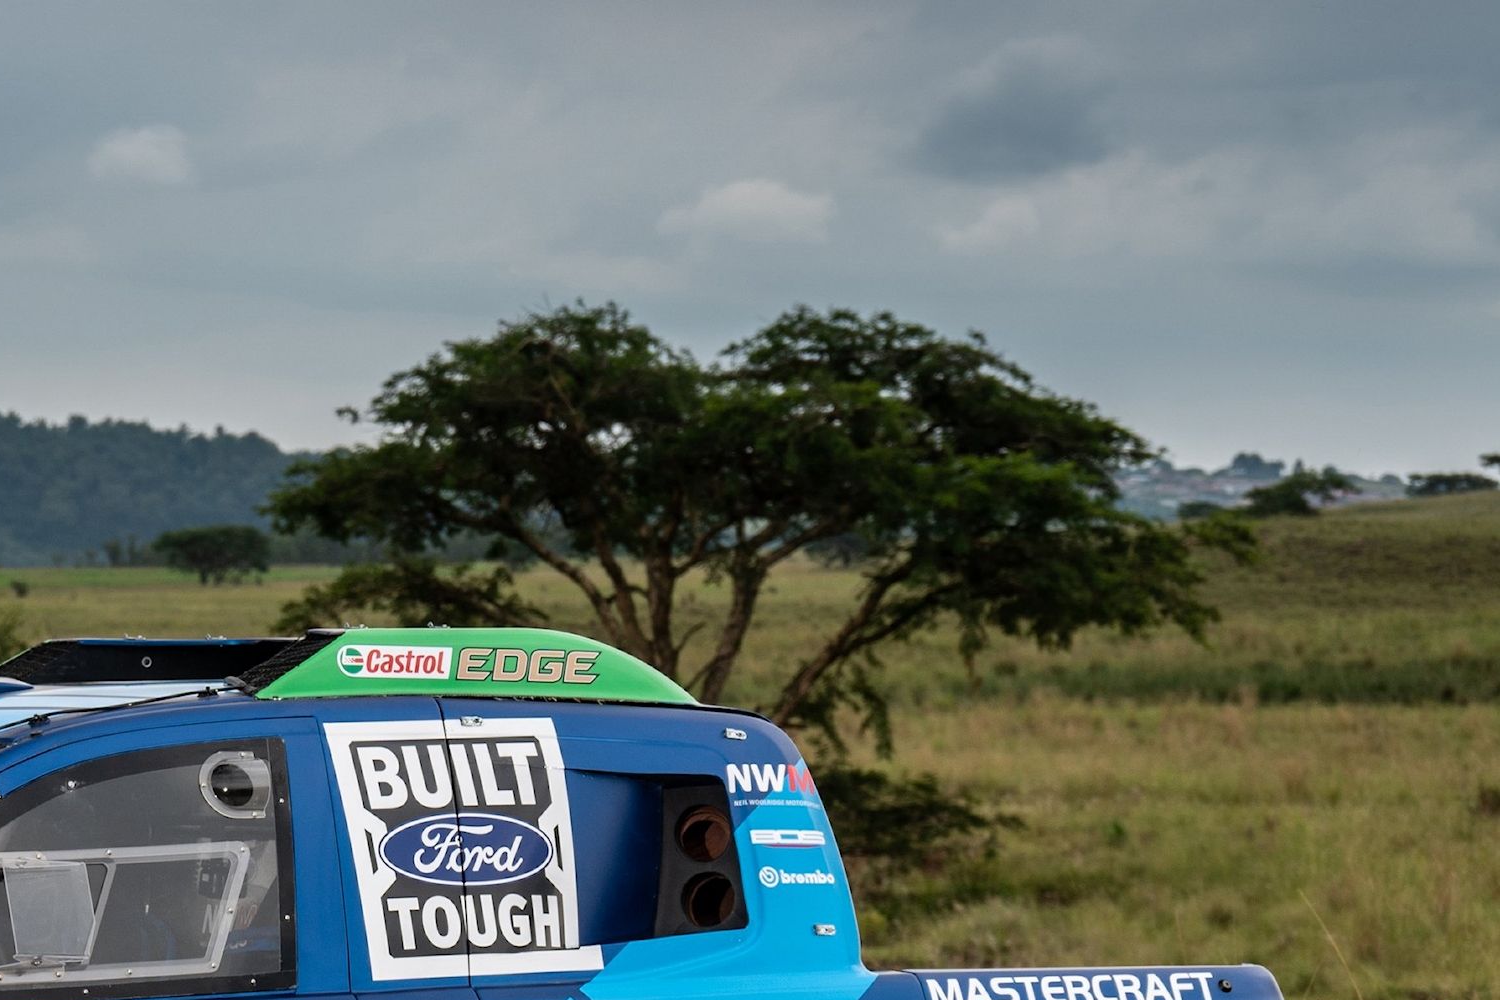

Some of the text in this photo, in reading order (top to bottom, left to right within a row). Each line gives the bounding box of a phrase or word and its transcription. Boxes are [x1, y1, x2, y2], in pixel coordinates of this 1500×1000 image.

[366, 647, 601, 684] Castrol EDGE
[356, 742, 539, 810] BUILT
[726, 763, 815, 795] NWM
[413, 823, 524, 874] Ford
[779, 869, 835, 885] brembo
[387, 893, 562, 950] TOUGH
